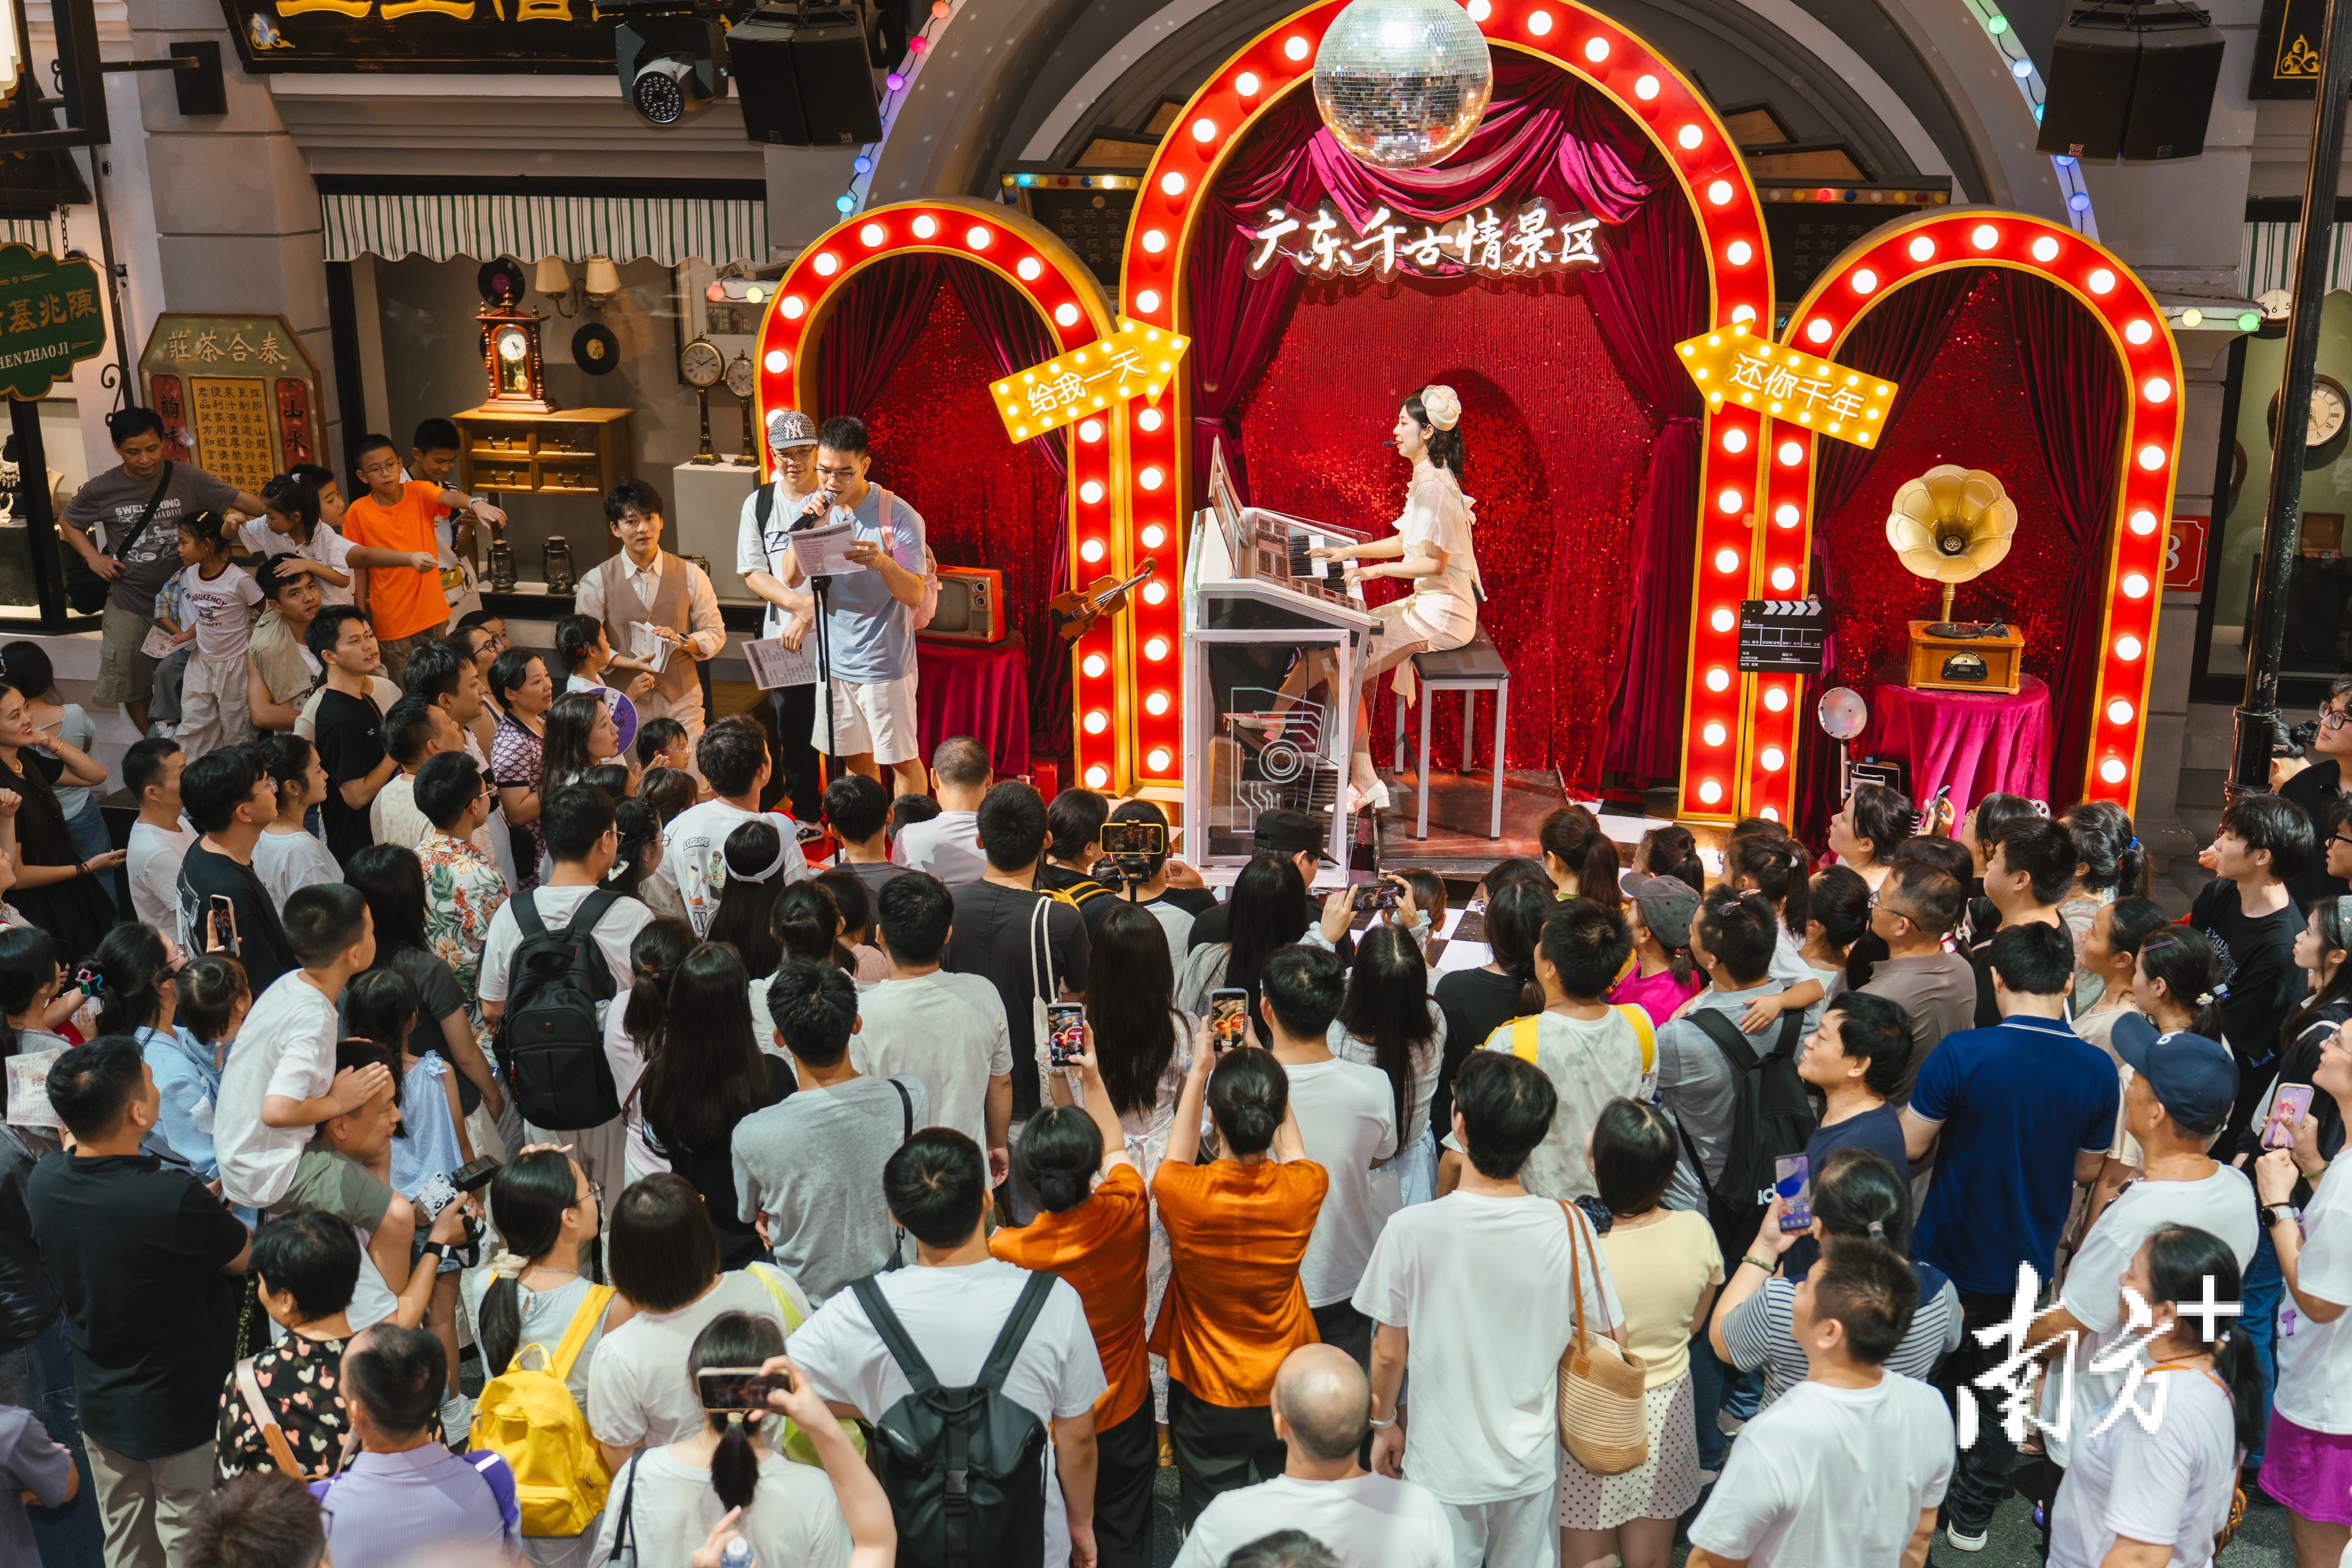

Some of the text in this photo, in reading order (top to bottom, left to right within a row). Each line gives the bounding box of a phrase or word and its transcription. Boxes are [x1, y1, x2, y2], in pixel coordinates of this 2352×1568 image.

[1060, 208, 1079, 252] 至誠至
[1253, 207, 1599, 274] 广东千古情景区
[24, 345, 56, 363] ZHAO
[58, 342, 70, 356] JI
[1027, 348, 1146, 417] 给我一天
[1729, 353, 1864, 422] 还你千年
[784, 418, 805, 439] NY
[115, 498, 181, 516] SWELRING
[153, 508, 182, 519] ARADISE
[683, 837, 710, 851] LEISURE
